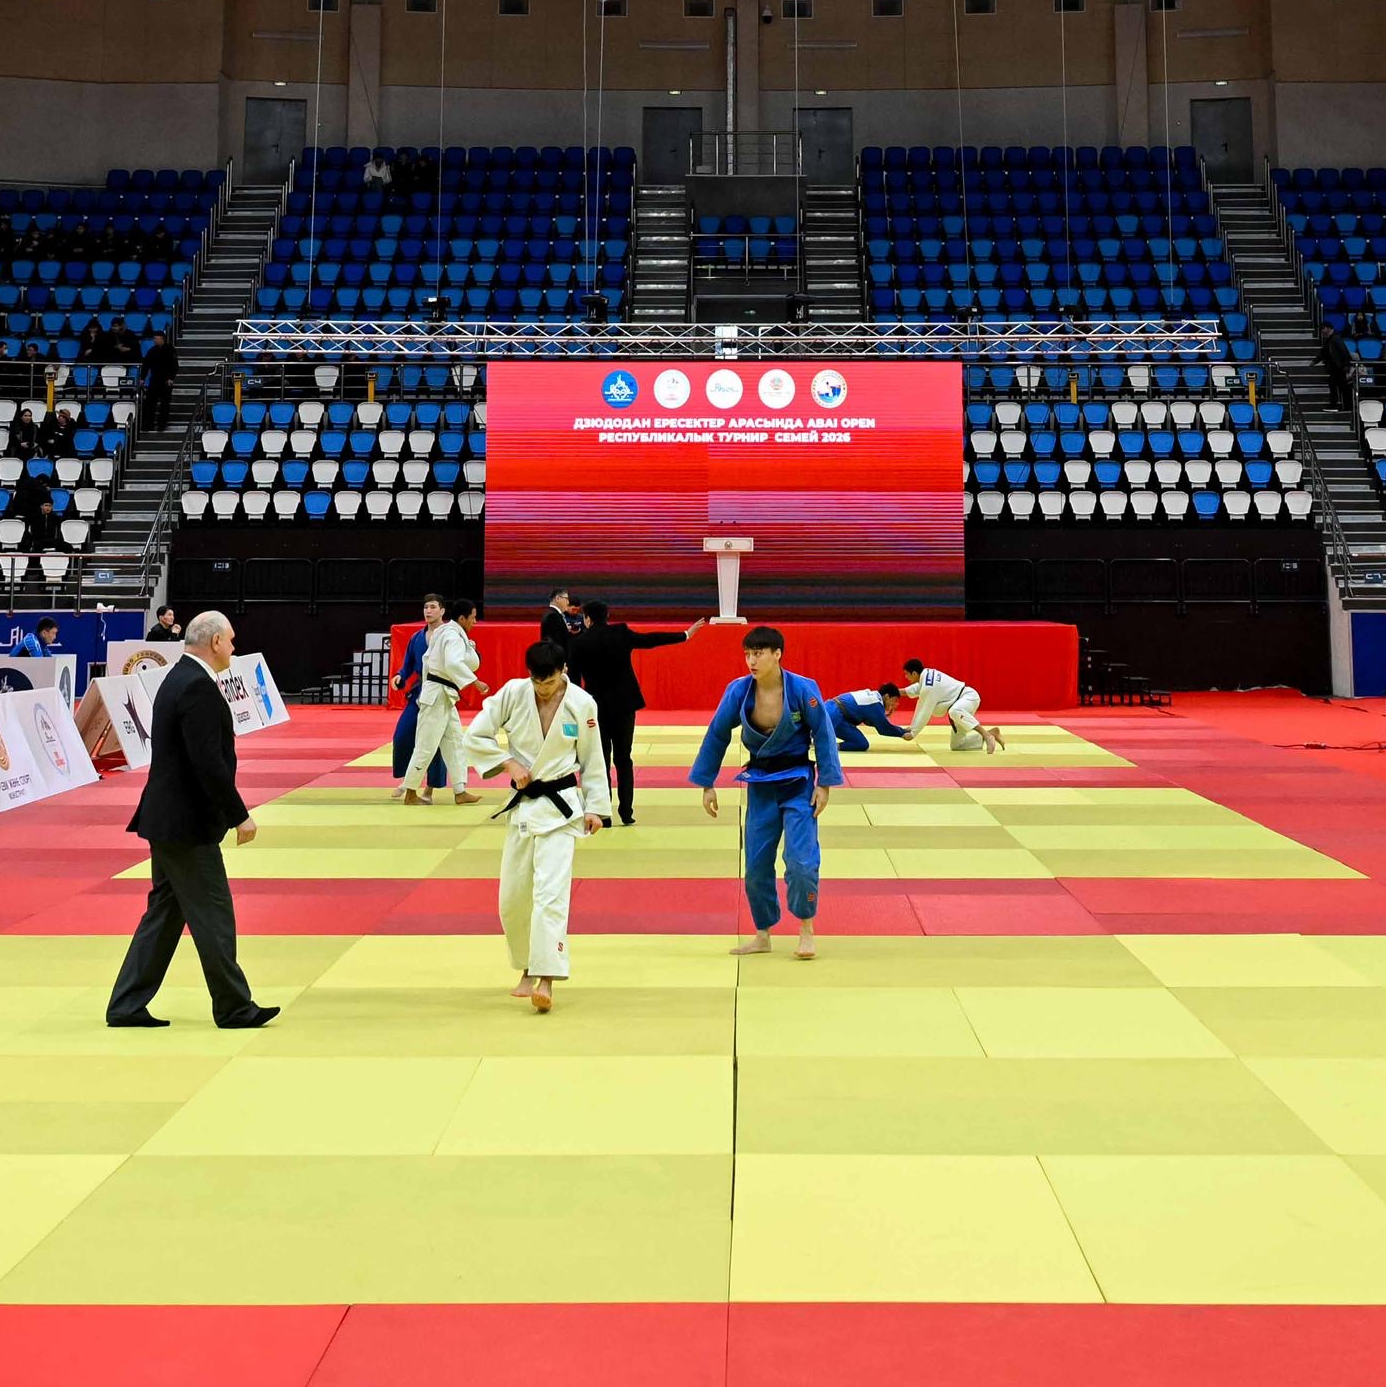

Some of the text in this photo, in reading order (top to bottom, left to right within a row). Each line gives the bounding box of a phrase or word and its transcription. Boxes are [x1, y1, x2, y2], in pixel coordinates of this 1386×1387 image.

[573, 418, 876, 430] ДЗЮДОДАН ЕРЕСЕКТЕР АРАСЫНДА ABAI OPEN
[717, 433, 768, 443] ТУРНИР
[774, 431, 819, 443] СЕМЕЙ
[821, 433, 851, 443] 2026
